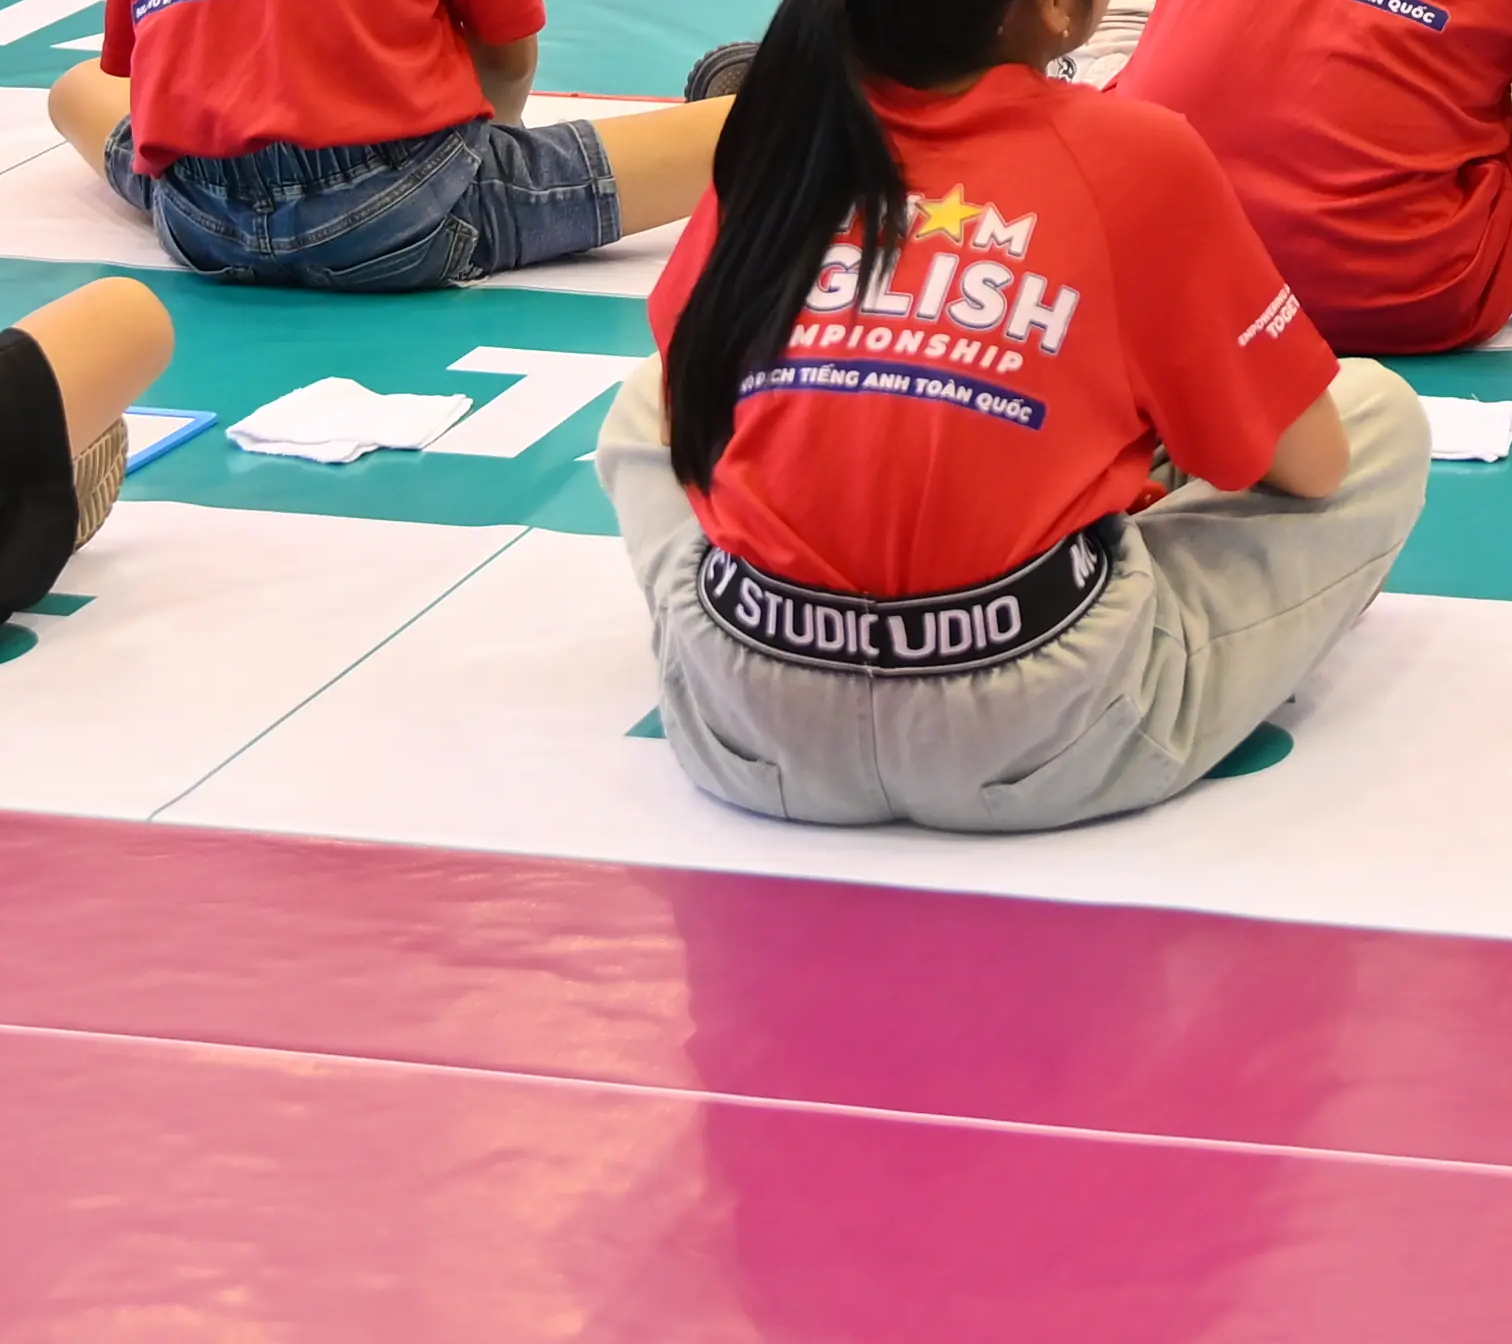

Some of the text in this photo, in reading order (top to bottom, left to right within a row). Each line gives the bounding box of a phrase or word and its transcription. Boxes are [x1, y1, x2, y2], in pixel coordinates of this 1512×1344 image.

[802, 243, 1078, 354] GLISH
[790, 322, 1022, 373] MPIONSHIP
[798, 359, 1033, 424] TIẾNG ANH TOÀN QUỐC
